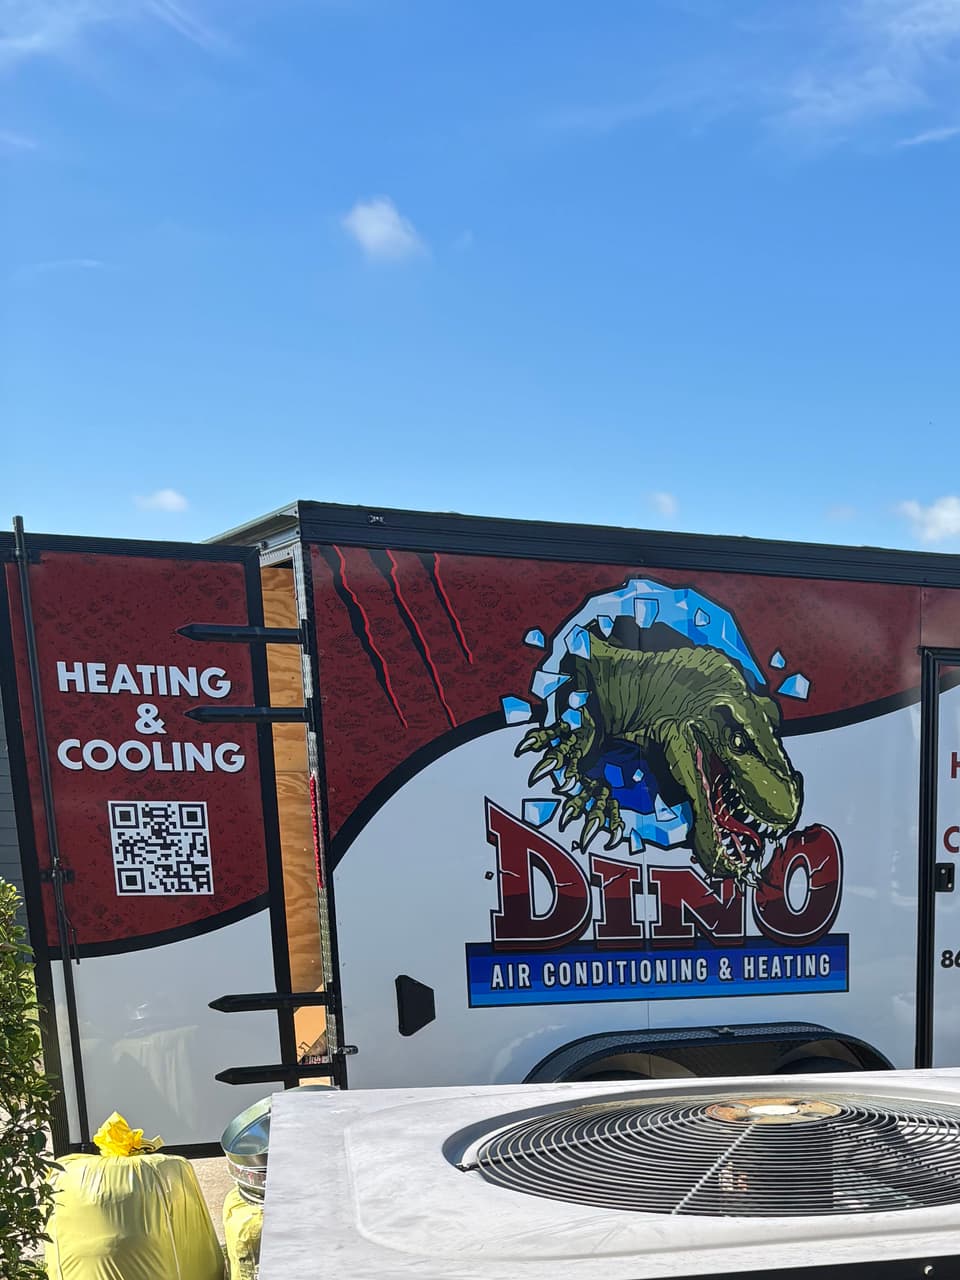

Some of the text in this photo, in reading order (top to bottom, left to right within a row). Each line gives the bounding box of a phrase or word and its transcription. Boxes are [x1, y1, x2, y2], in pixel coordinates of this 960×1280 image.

[56, 661, 232, 698] HEATING
[135, 703, 166, 734] &
[57, 738, 246, 773] COOLING
[484, 797, 843, 950] DINO
[491, 954, 832, 991] AIR CONDITIONING & HEATING
